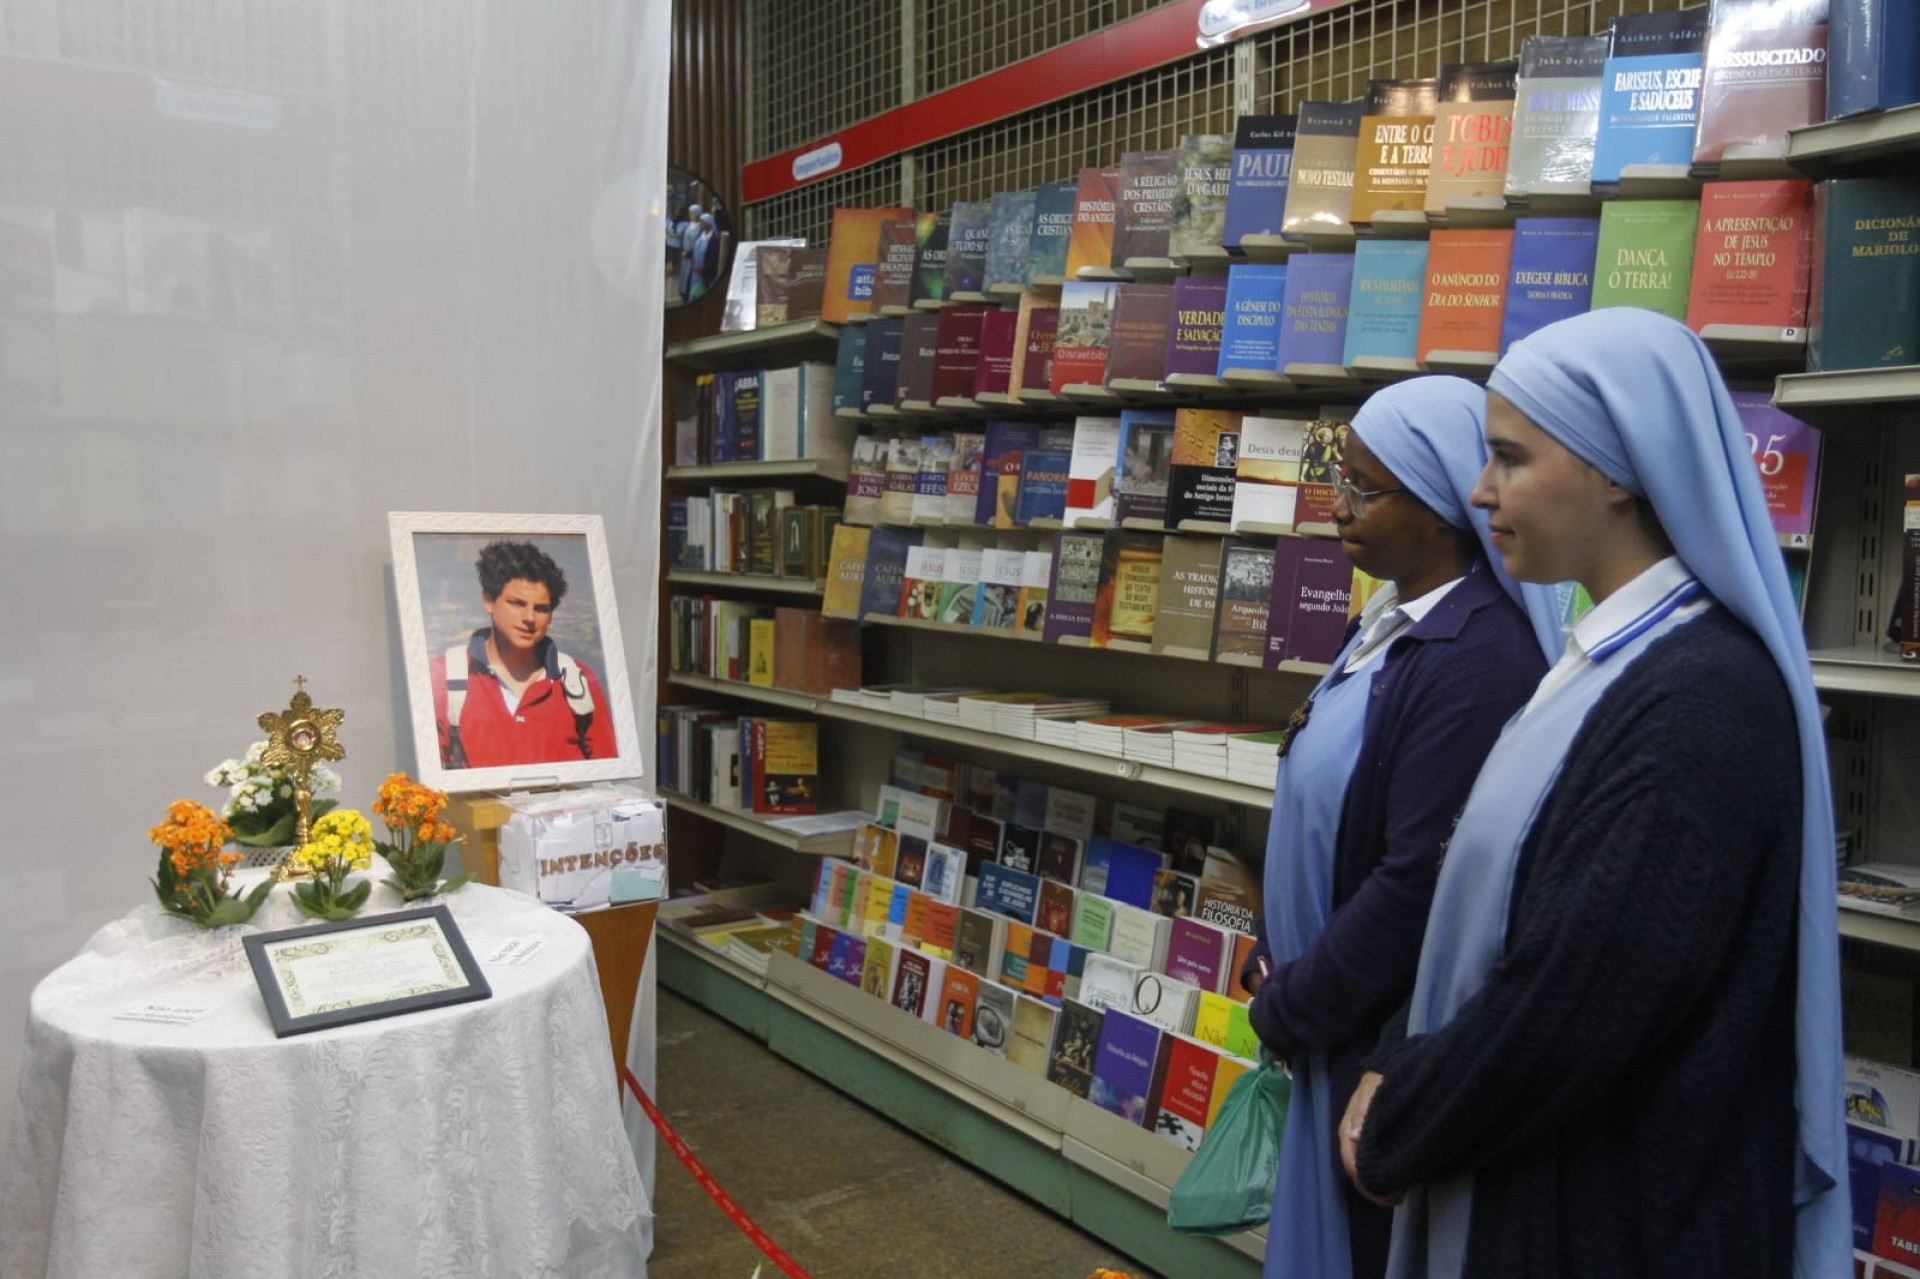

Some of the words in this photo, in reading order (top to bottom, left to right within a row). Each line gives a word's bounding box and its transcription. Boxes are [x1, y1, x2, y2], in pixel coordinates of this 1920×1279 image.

[1614, 70, 1662, 91] FARISEUS,
[1629, 91, 1637, 111] E
[1637, 89, 1693, 112] SADUCEUS
[1375, 124, 1408, 144] ENTRE
[1410, 125, 1420, 144] O
[1379, 145, 1390, 164] E
[1390, 146, 1399, 164] A
[1297, 168, 1323, 185] NOVO
[1704, 219, 1712, 232] A
[1715, 215, 1794, 234] APRESENTAÇÃO
[1724, 235, 1738, 249] DE
[1742, 234, 1769, 250] JESUS
[1888, 230, 1909, 242] DE
[1617, 248, 1669, 271] DANÇA
[1713, 252, 1731, 266] NO
[1734, 252, 1776, 267] TEMPLO
[1432, 273, 1440, 286] O
[1440, 271, 1484, 287] ANÚNCIO
[1485, 273, 1500, 286] DO
[1516, 271, 1552, 285] EXEGESE
[1553, 269, 1589, 287] BÍBLICA
[1624, 271, 1672, 290] TERRA!
[1235, 301, 1241, 312] A
[1267, 301, 1281, 312] DO
[1428, 293, 1446, 308] DIA
[1448, 294, 1463, 308] DO
[1464, 293, 1500, 308] SENHOR
[1237, 313, 1276, 327] DISCÍPULO
[1176, 328, 1183, 342] E
[1786, 328, 1796, 338] D
[1057, 349, 1066, 360] O
[1247, 442, 1275, 455] Deus
[1794, 535, 1804, 544] A
[1173, 571, 1185, 581] AS
[1300, 586, 1352, 602] Evangelho
[1189, 598, 1203, 608] DE
[1299, 601, 1331, 613] segundo
[540, 840, 667, 877] INTENÇÕES
[1204, 896, 1241, 916] HISTÓRIA
[1241, 907, 1254, 921] DA
[1201, 907, 1251, 934] FILOSOFIA
